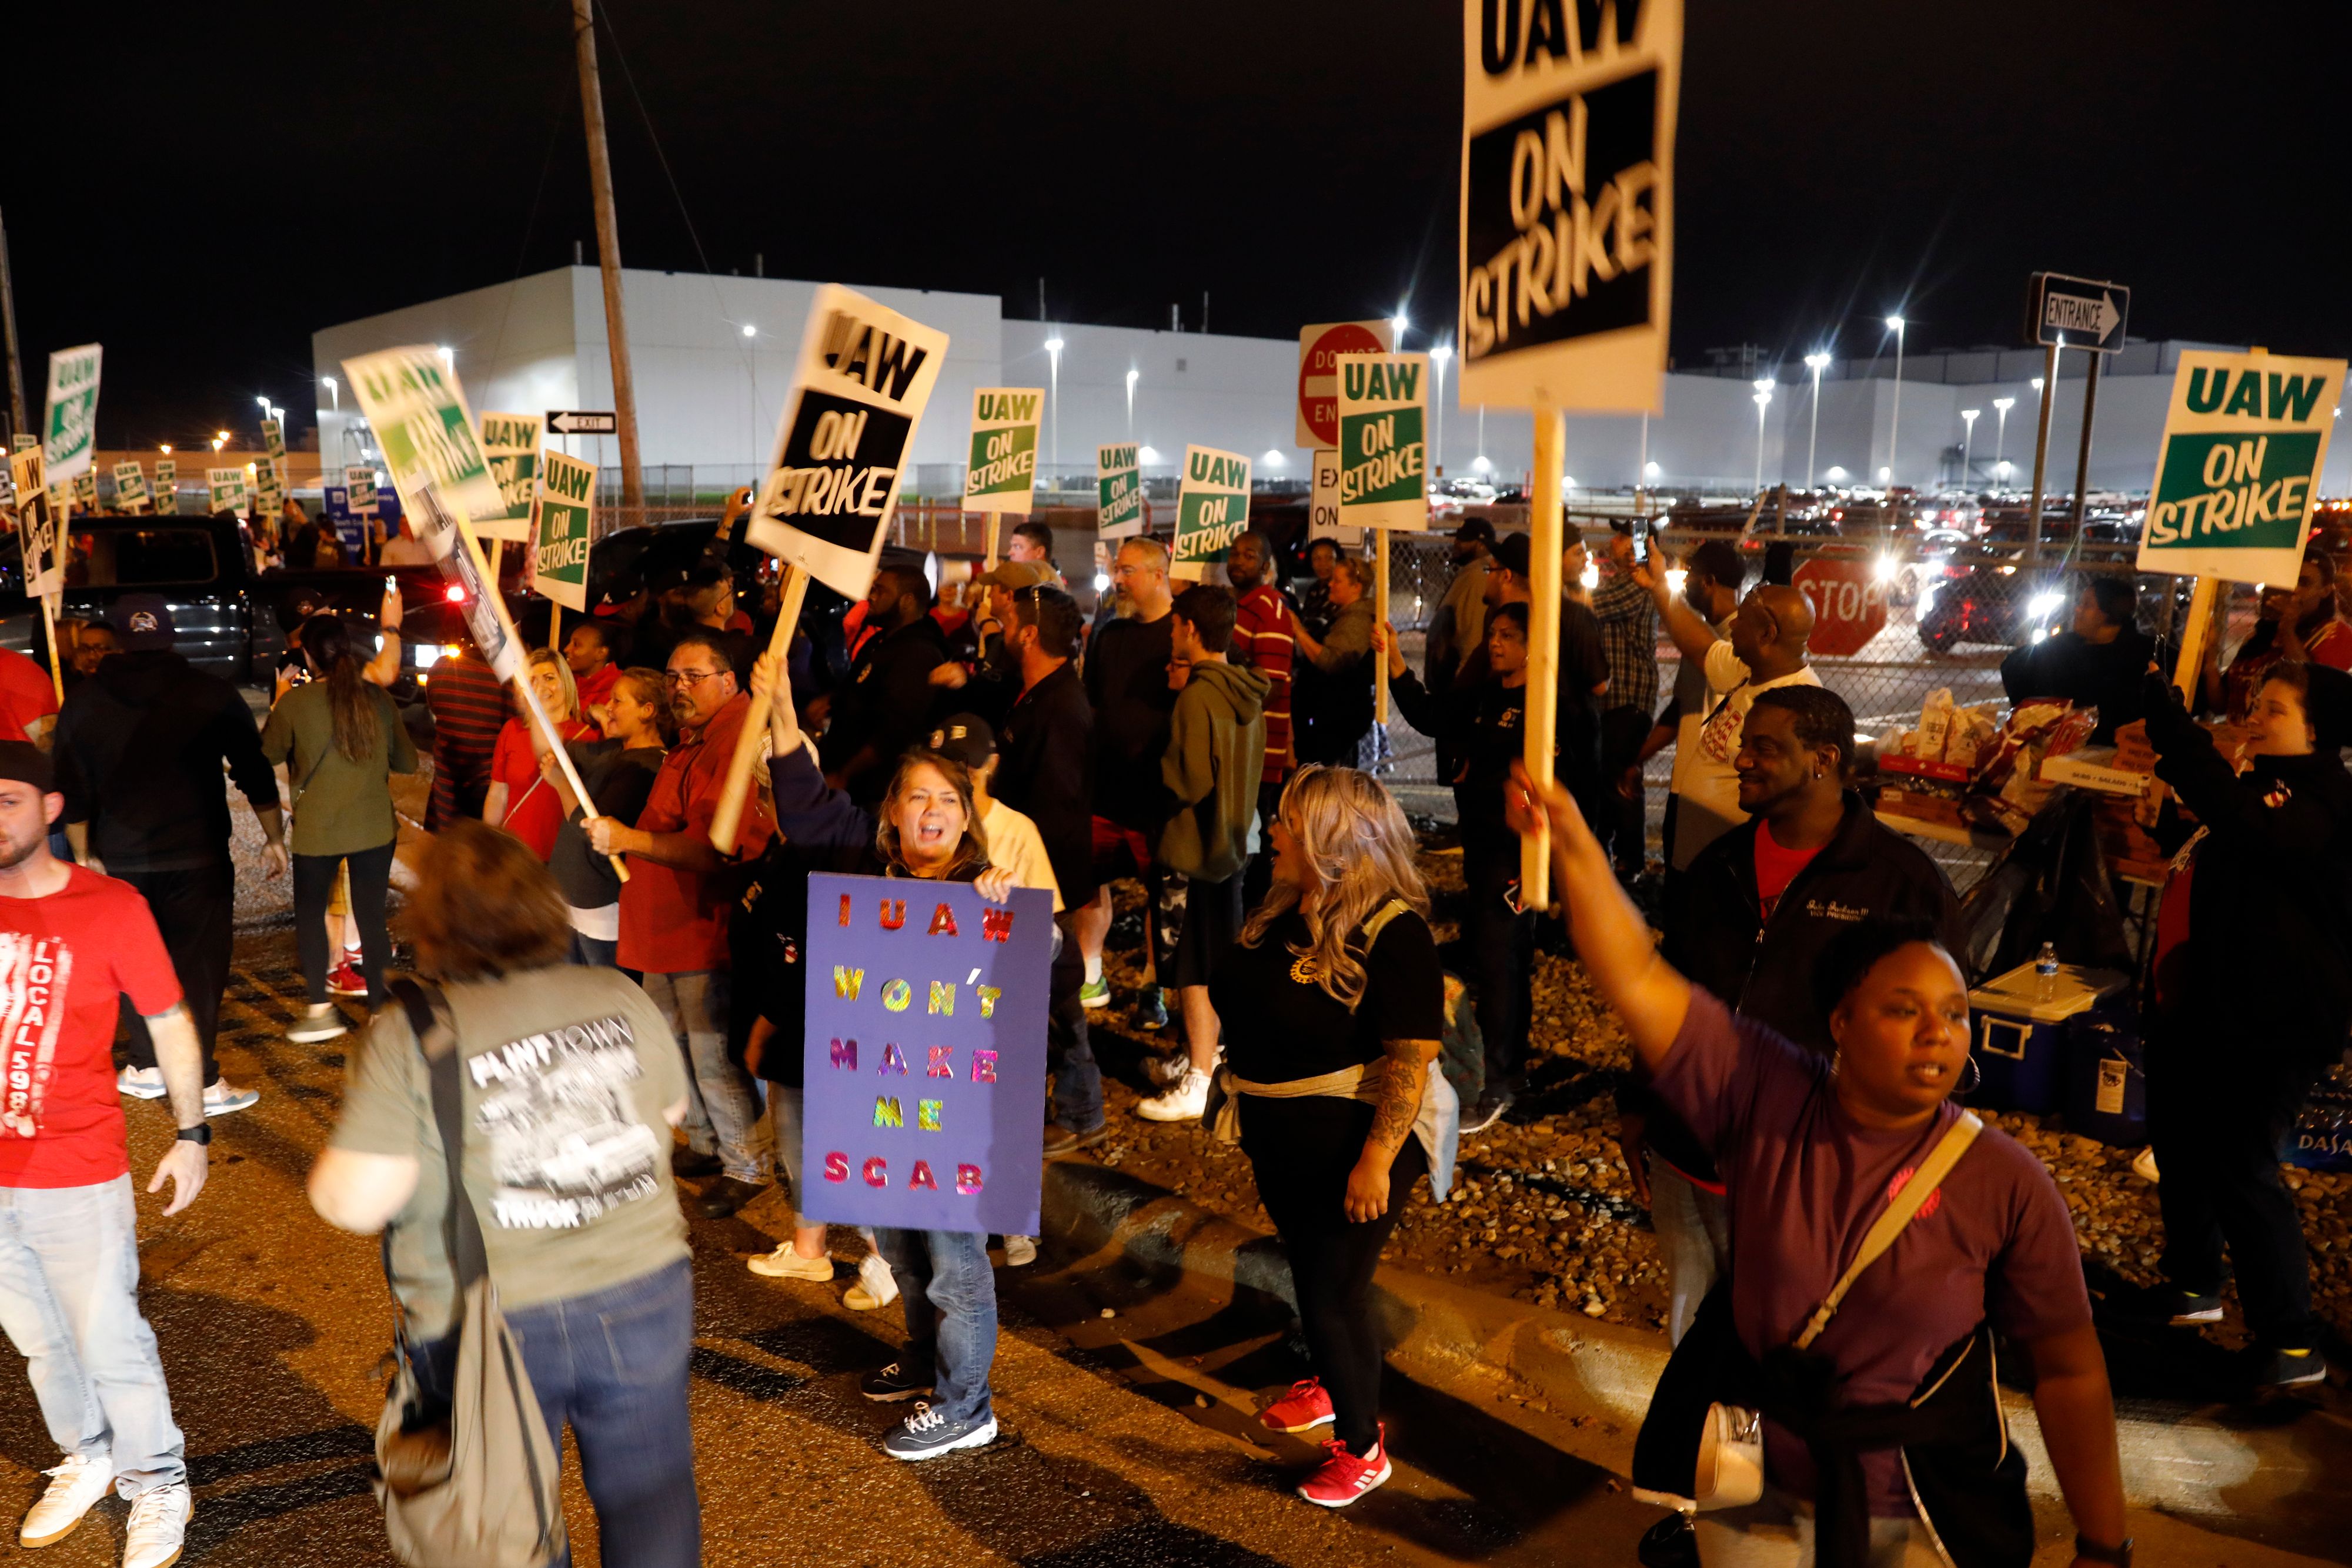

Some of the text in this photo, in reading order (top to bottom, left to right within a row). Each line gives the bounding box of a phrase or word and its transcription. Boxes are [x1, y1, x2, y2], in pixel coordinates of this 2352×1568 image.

[1511, 94, 1588, 230] ON
[1468, 160, 1657, 359] STRIKE
[2047, 296, 2103, 330] ENTRANCE
[1345, 363, 1420, 400] UAW
[2186, 366, 2327, 423] UAW
[577, 418, 601, 427] EXIT
[979, 394, 1037, 420] UAW
[484, 419, 537, 448] UAW
[810, 410, 868, 460] ON
[987, 430, 1014, 460] ON
[1362, 414, 1394, 457] ON
[213, 472, 241, 482] UAW
[350, 471, 373, 480] UAW
[968, 450, 1033, 493] STRIKE
[1101, 447, 1136, 469] UAW
[1190, 452, 1247, 489] UAW
[1342, 442, 1423, 502] STRIKE
[2203, 436, 2268, 488] ON
[547, 458, 592, 502] UAW
[766, 464, 897, 516] STRIKE
[1111, 475, 1127, 499] ON
[552, 509, 571, 539] ON
[1100, 488, 1139, 525] STRIKE
[1199, 497, 1228, 526] ON
[2151, 476, 2310, 544] STRIKE
[538, 538, 587, 573] STRIKE
[1800, 580, 1881, 621] STOP
[838, 894, 1015, 943] I UAW
[22, 941, 54, 1047] LOCAL
[830, 1037, 998, 1083] MAKE
[873, 1096, 943, 1132] ME
[824, 1151, 984, 1195] SCAB
